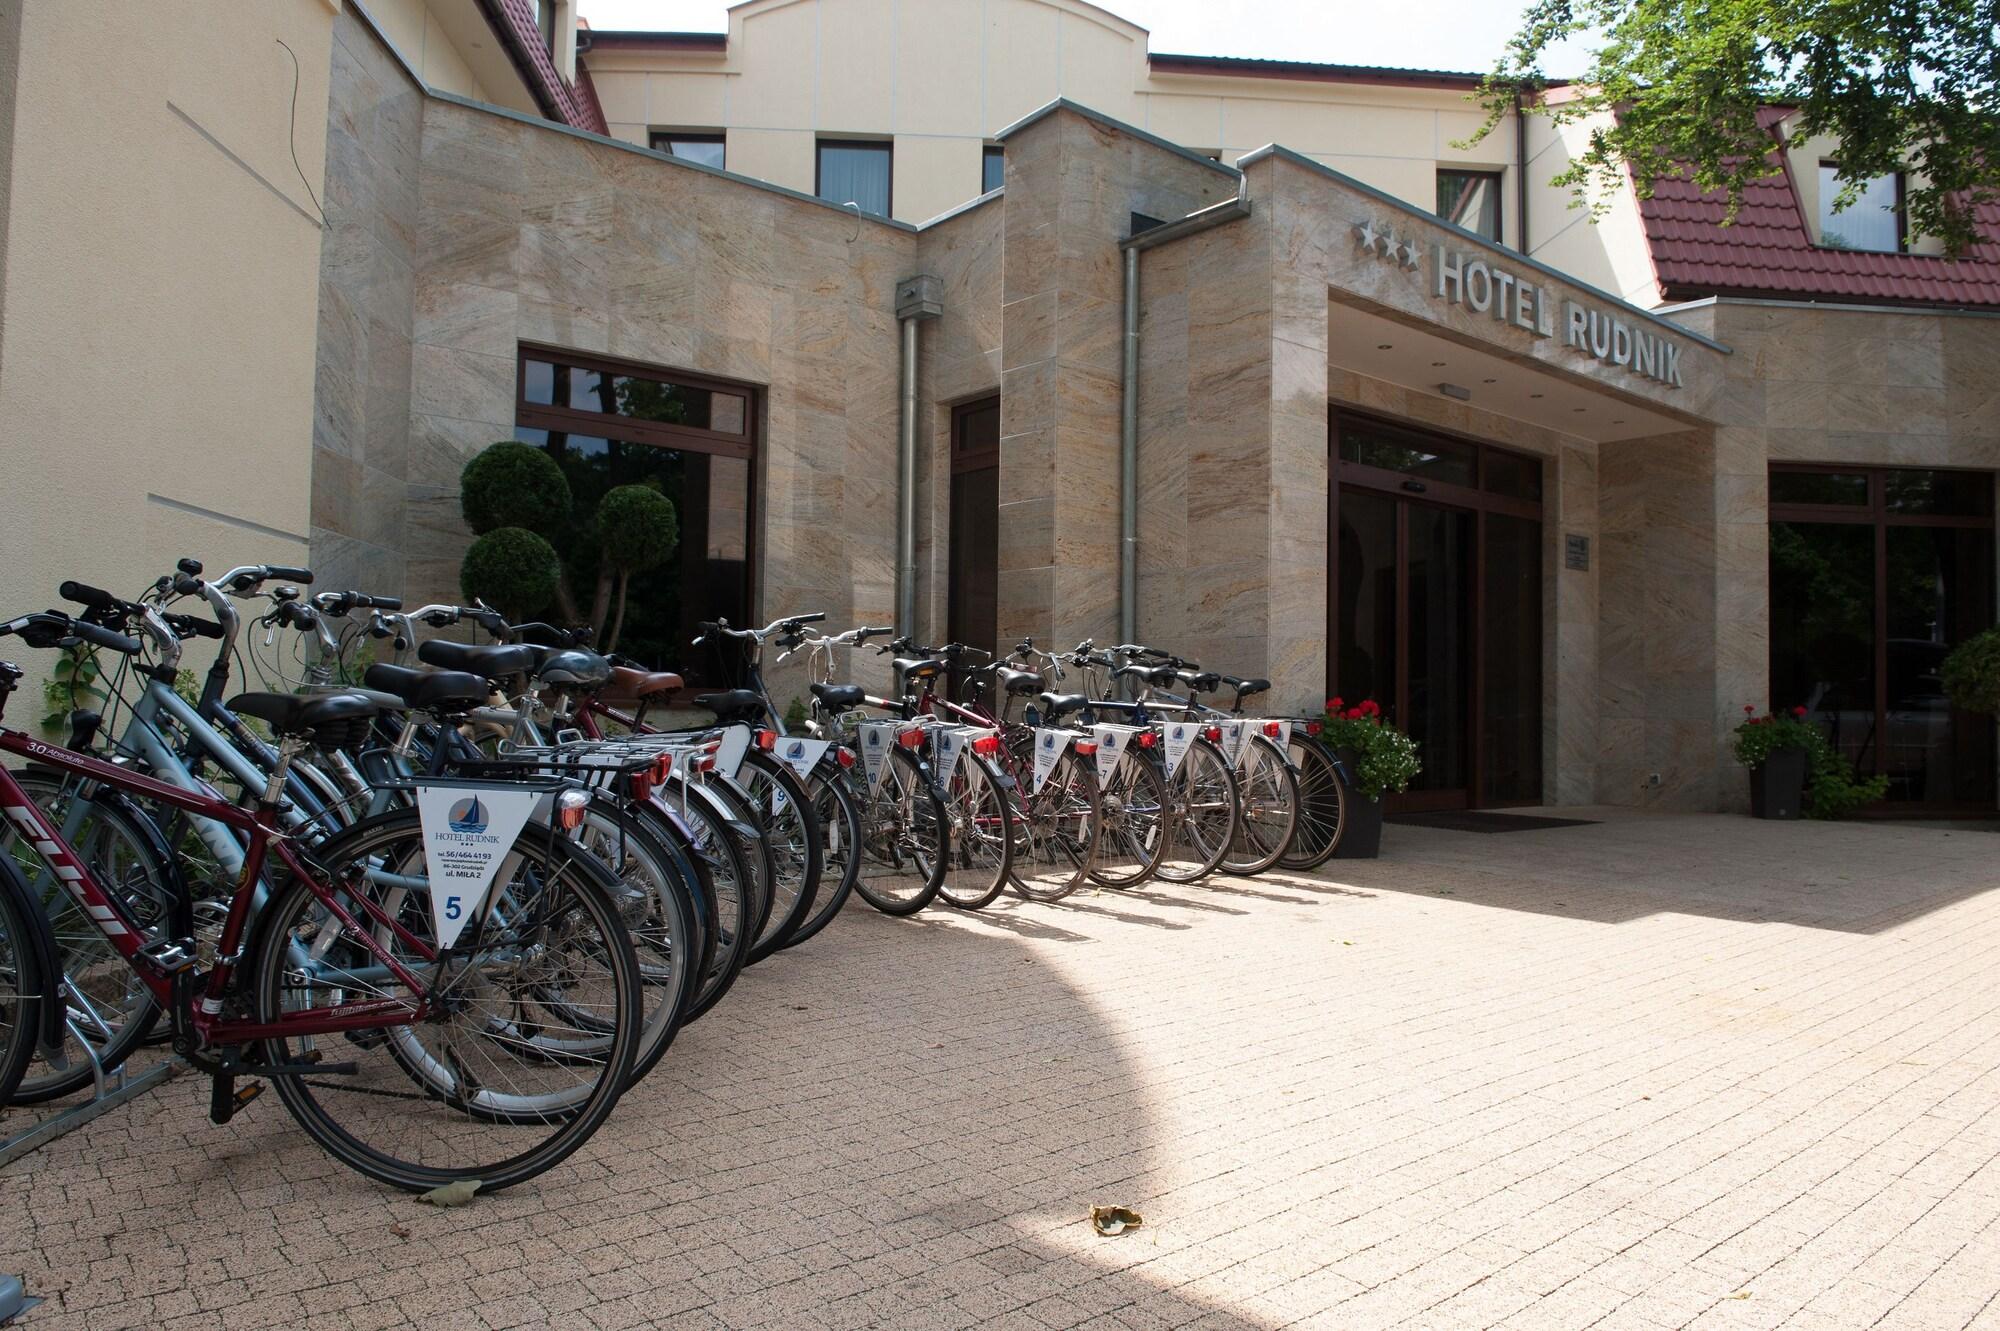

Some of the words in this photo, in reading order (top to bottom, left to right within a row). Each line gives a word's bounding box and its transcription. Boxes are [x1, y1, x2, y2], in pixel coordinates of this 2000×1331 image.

[1434, 246, 1553, 338] HOTEL
[1567, 301, 1683, 389] RUDNIK
[26, 741, 47, 755] 3.0
[47, 748, 84, 765] Absolute
[1168, 762, 1174, 772] 3
[868, 772, 877, 784] 10
[1036, 774, 1042, 784] 4
[777, 790, 785, 801] 9
[435, 832, 464, 841] HOTEL
[465, 834, 500, 843] RUDNIK
[446, 850, 472, 858] 56/464
[4, 806, 129, 935] FUJI
[445, 896, 462, 920] 5
